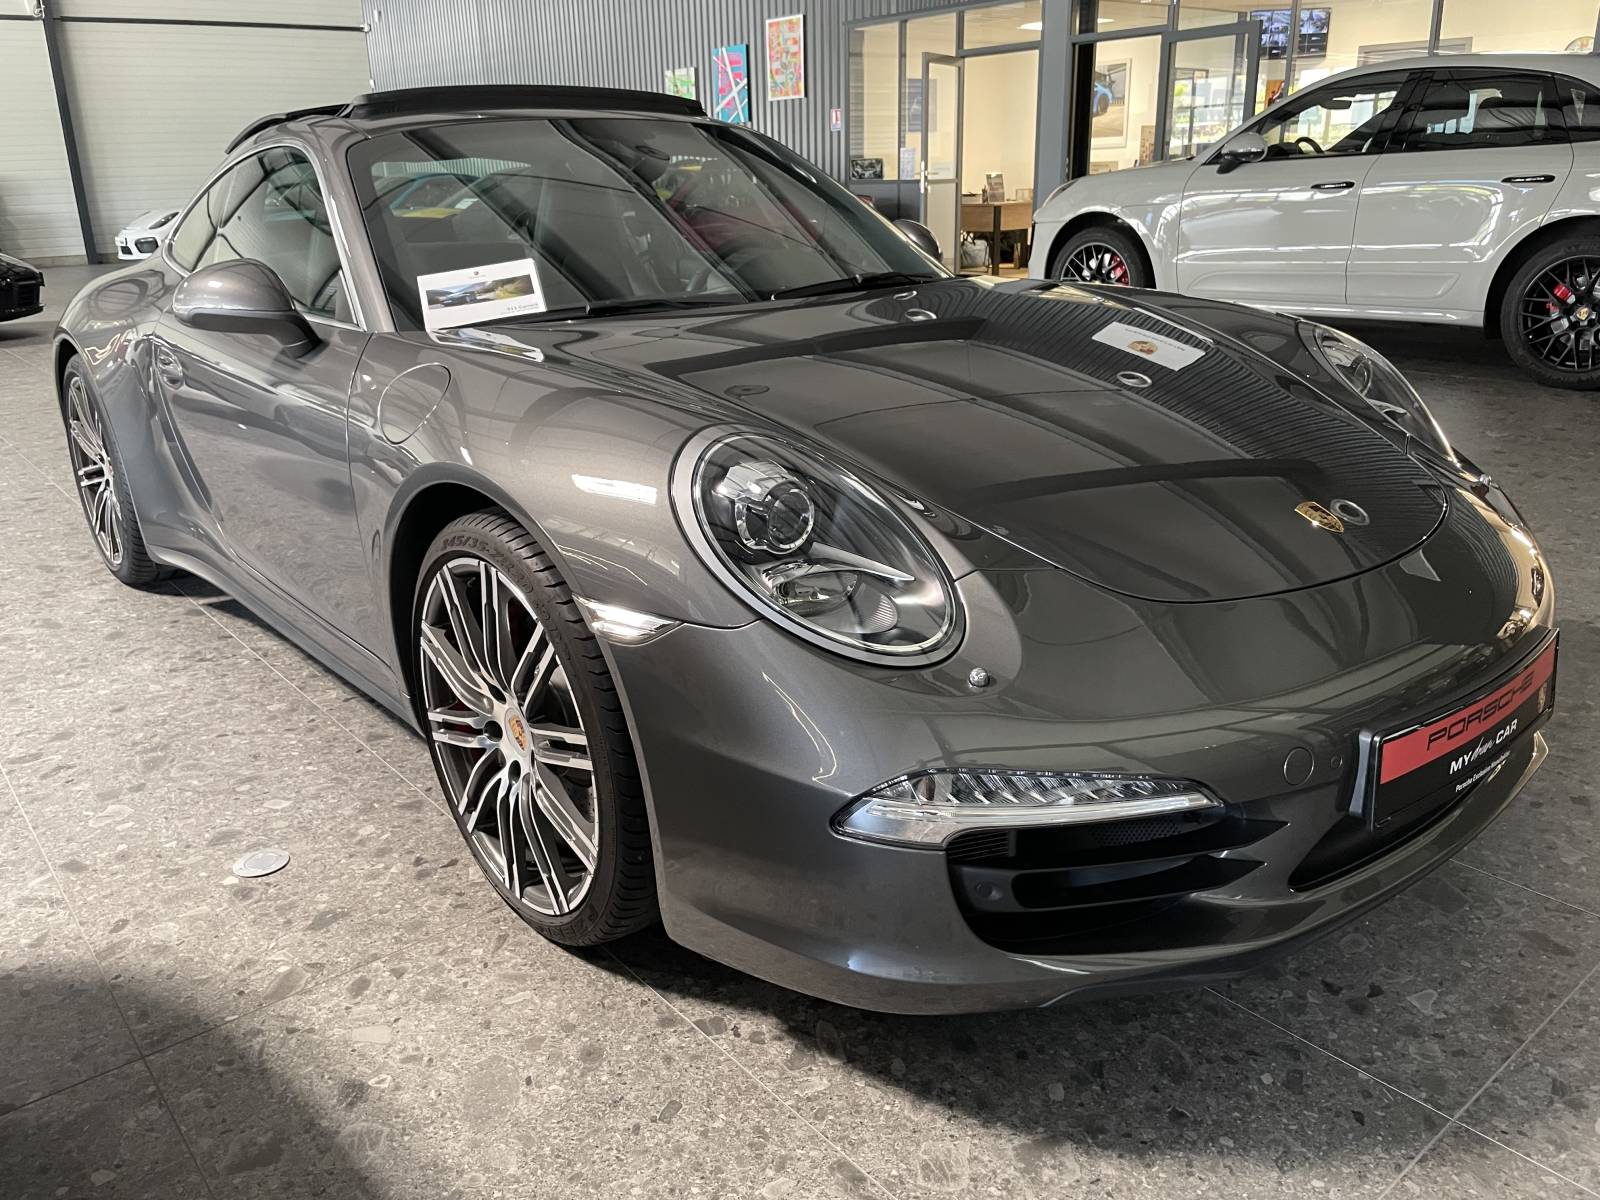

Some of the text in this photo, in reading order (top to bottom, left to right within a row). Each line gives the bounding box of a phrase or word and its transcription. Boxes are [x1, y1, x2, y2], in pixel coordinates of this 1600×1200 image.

[1427, 671, 1535, 751] PORSCHE
[1449, 750, 1473, 775] MY
[1495, 718, 1518, 745] CAR
